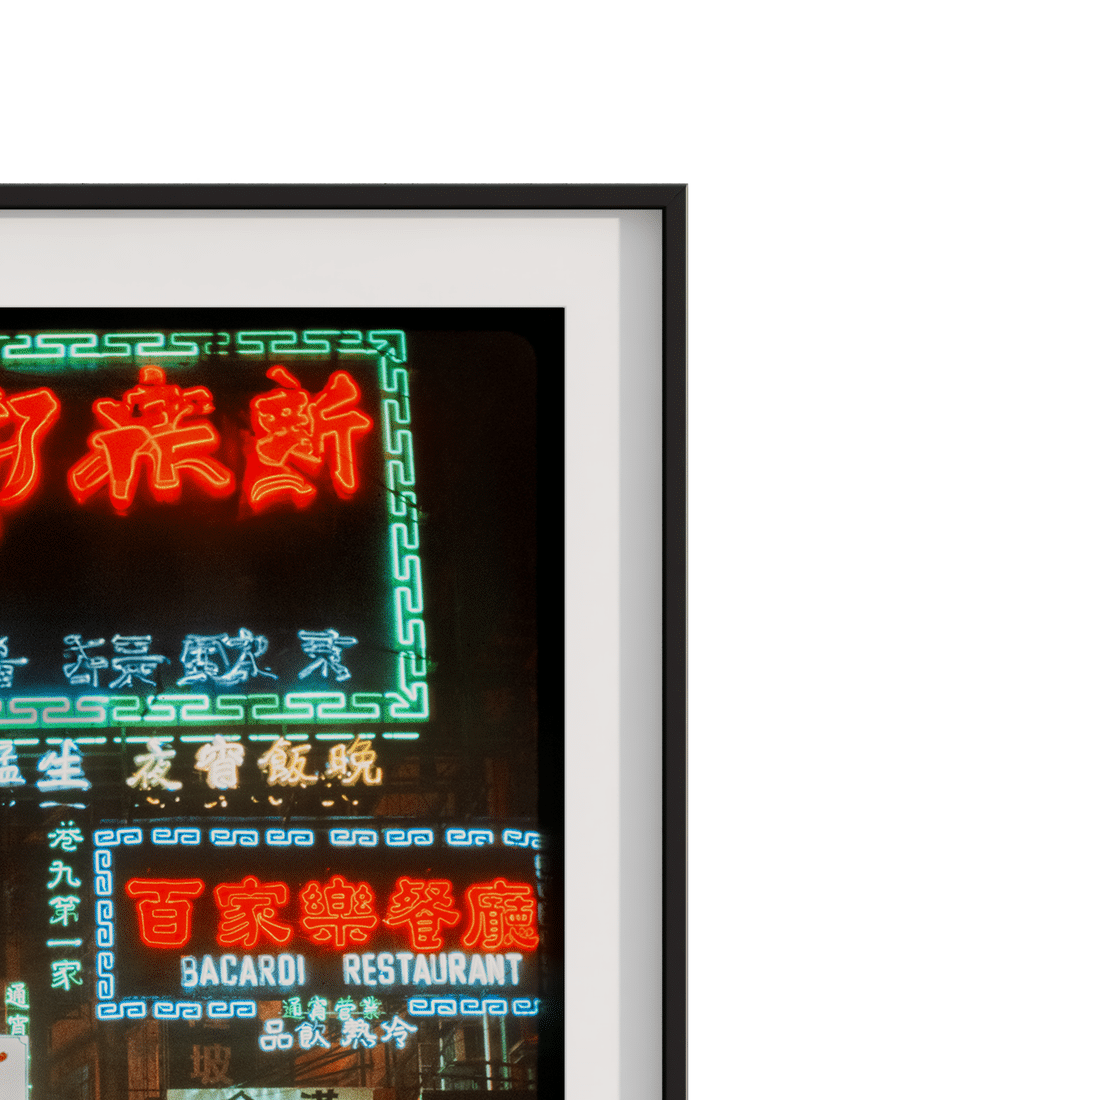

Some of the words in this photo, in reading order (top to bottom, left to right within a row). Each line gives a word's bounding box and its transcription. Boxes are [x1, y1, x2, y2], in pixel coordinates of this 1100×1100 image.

[126, 875, 540, 950] 百家樂餐廳
[181, 954, 305, 988] BACARDI
[343, 952, 524, 987] RESTAURANT
